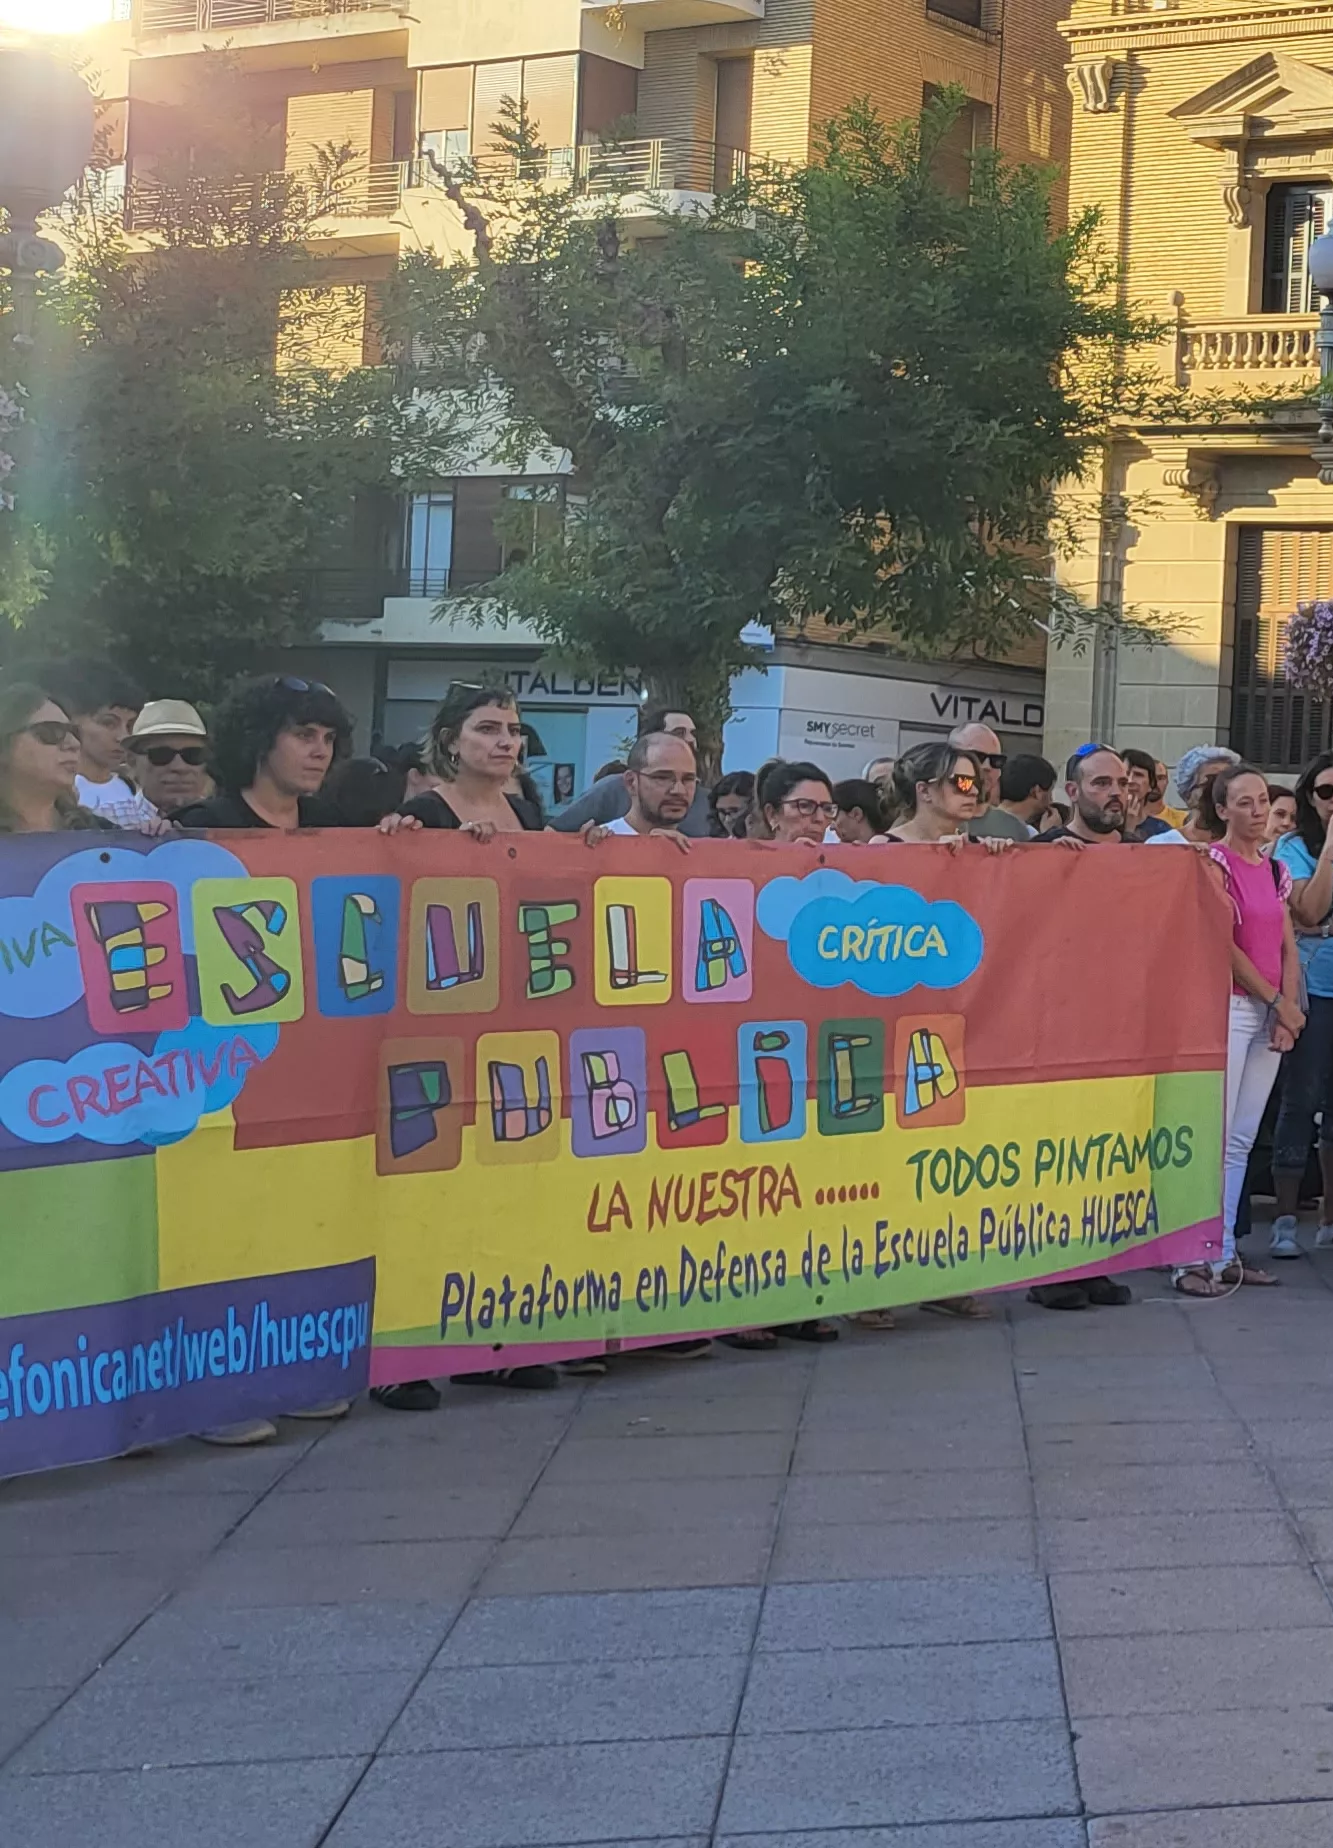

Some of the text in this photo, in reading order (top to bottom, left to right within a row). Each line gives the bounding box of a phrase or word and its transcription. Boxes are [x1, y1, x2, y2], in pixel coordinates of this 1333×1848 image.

[930, 692, 1044, 727] VITALD
[85, 893, 748, 1015] ESCUELA
[817, 916, 949, 962] CRÍTICA
[28, 1036, 263, 1128] CREATIVA
[587, 1180, 633, 1232] LA
[648, 1163, 802, 1233] NUESTRA
[907, 1125, 1195, 1201] TODOS PINTAMOS
[440, 1187, 1159, 1339] Plataforma en Defensa de la Escuela Pública HUESCA
